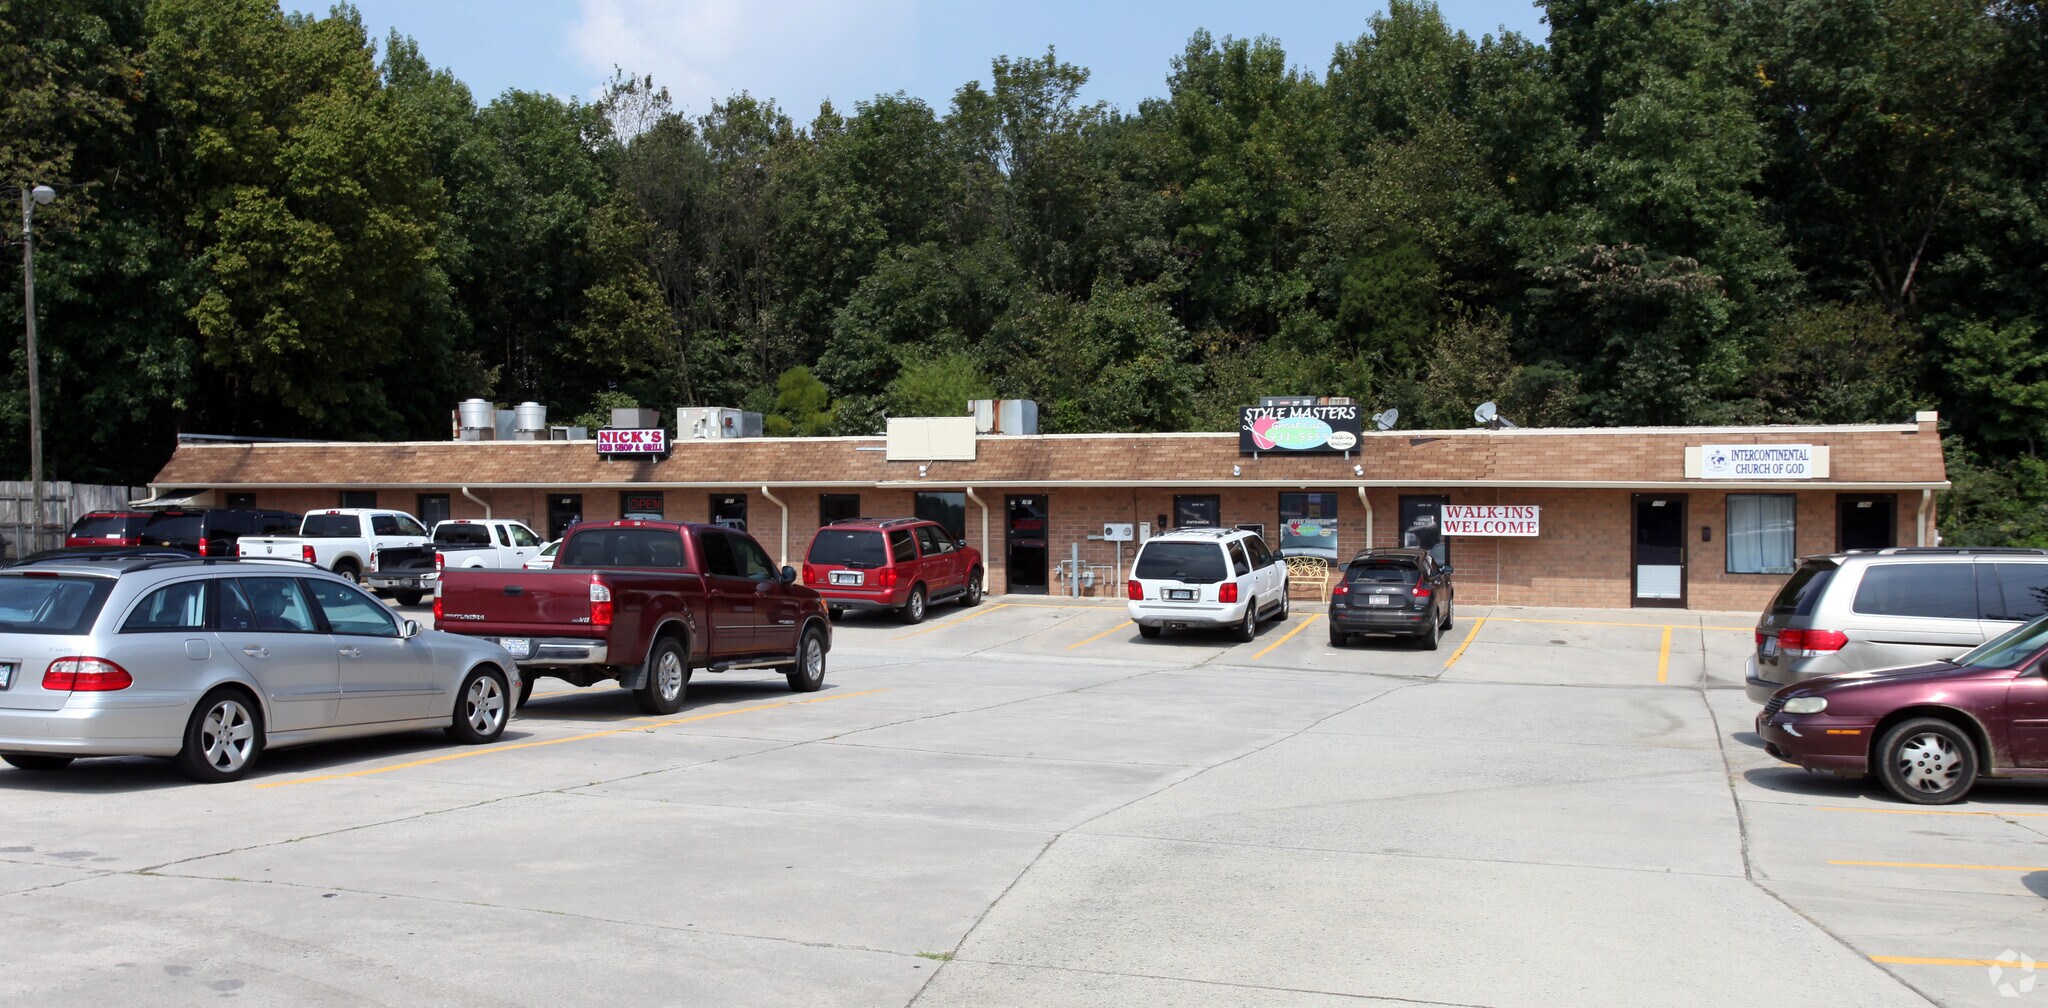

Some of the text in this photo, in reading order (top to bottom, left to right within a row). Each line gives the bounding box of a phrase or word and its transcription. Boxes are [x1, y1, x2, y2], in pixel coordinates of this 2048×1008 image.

[1244, 406, 1356, 420] STYLE MASTERS
[1271, 421, 1300, 430] Great
[599, 431, 662, 443] NICK'S
[599, 443, 663, 451] SUB SHOP & GRILL
[1731, 449, 1809, 461] INTERCONTINENTAL
[1735, 463, 1805, 474] CHURCH OF GOD
[630, 498, 661, 510] OPEN
[1446, 506, 1534, 519] WALK-INS
[1443, 521, 1537, 534] WELCOME
